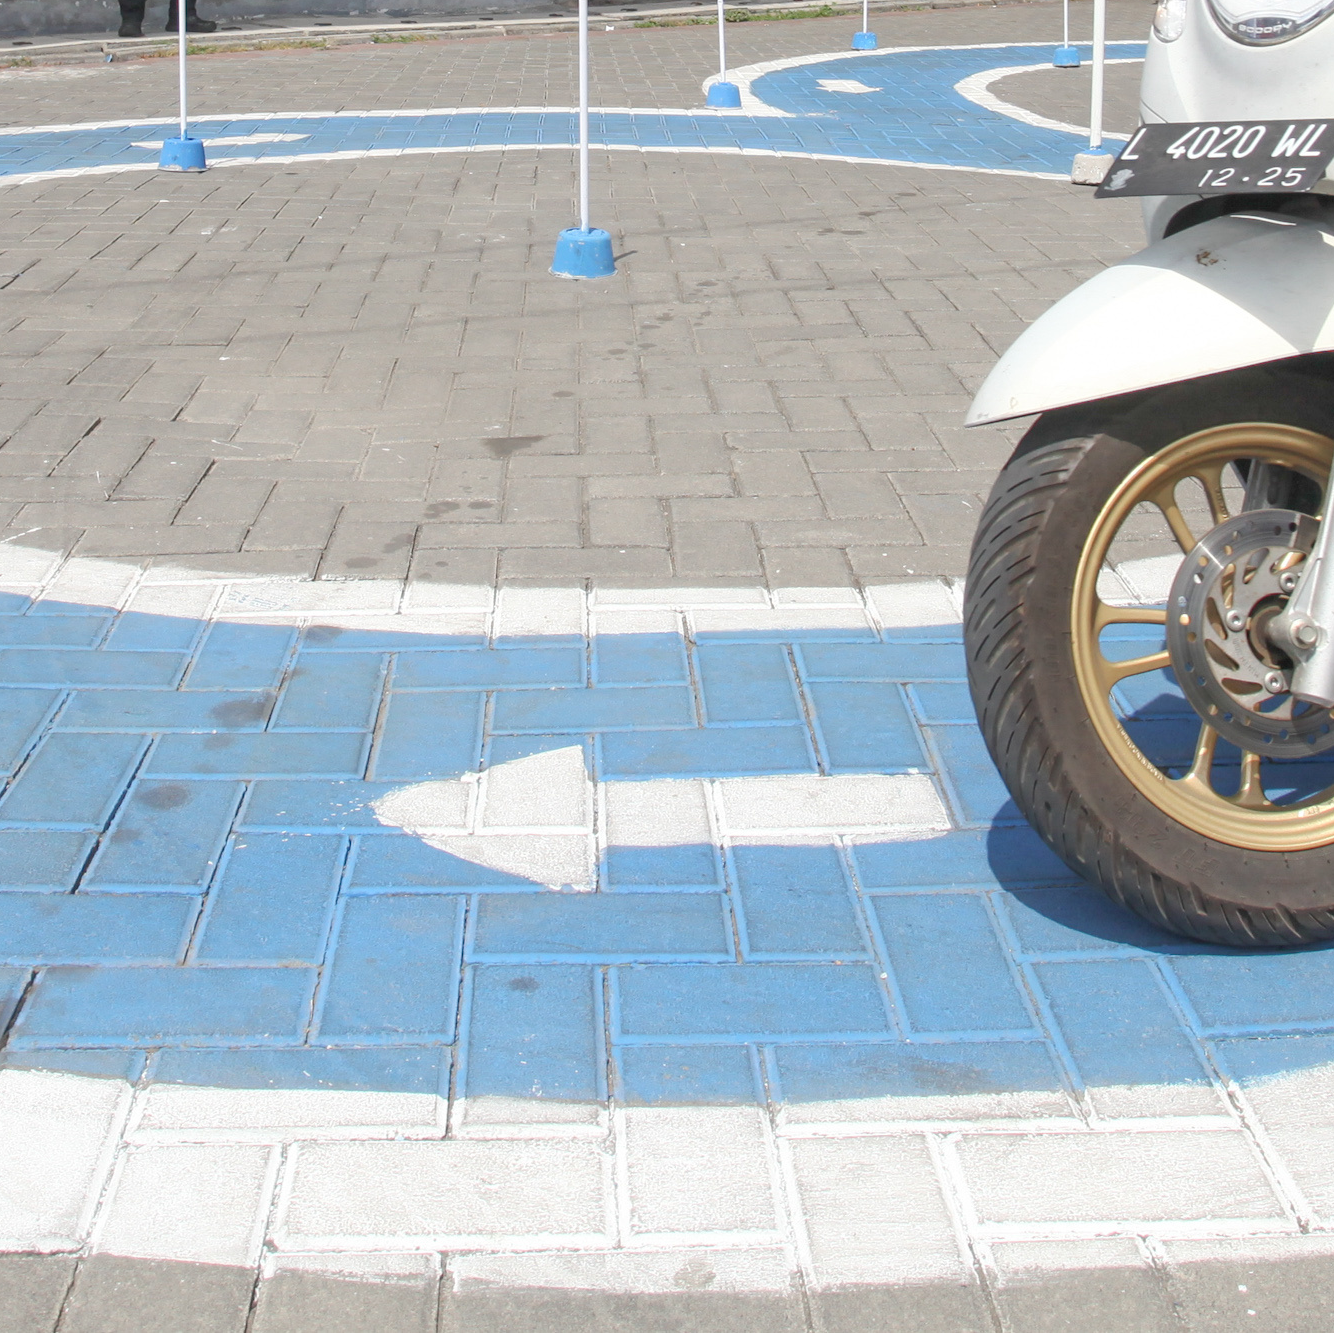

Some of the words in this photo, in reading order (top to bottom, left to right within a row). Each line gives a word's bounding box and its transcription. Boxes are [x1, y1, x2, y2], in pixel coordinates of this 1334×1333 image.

[1238, 20, 1293, 36] SCOOPY
[1121, 126, 1149, 161] L
[1166, 124, 1267, 160] 4020
[1270, 123, 1328, 159] WL
